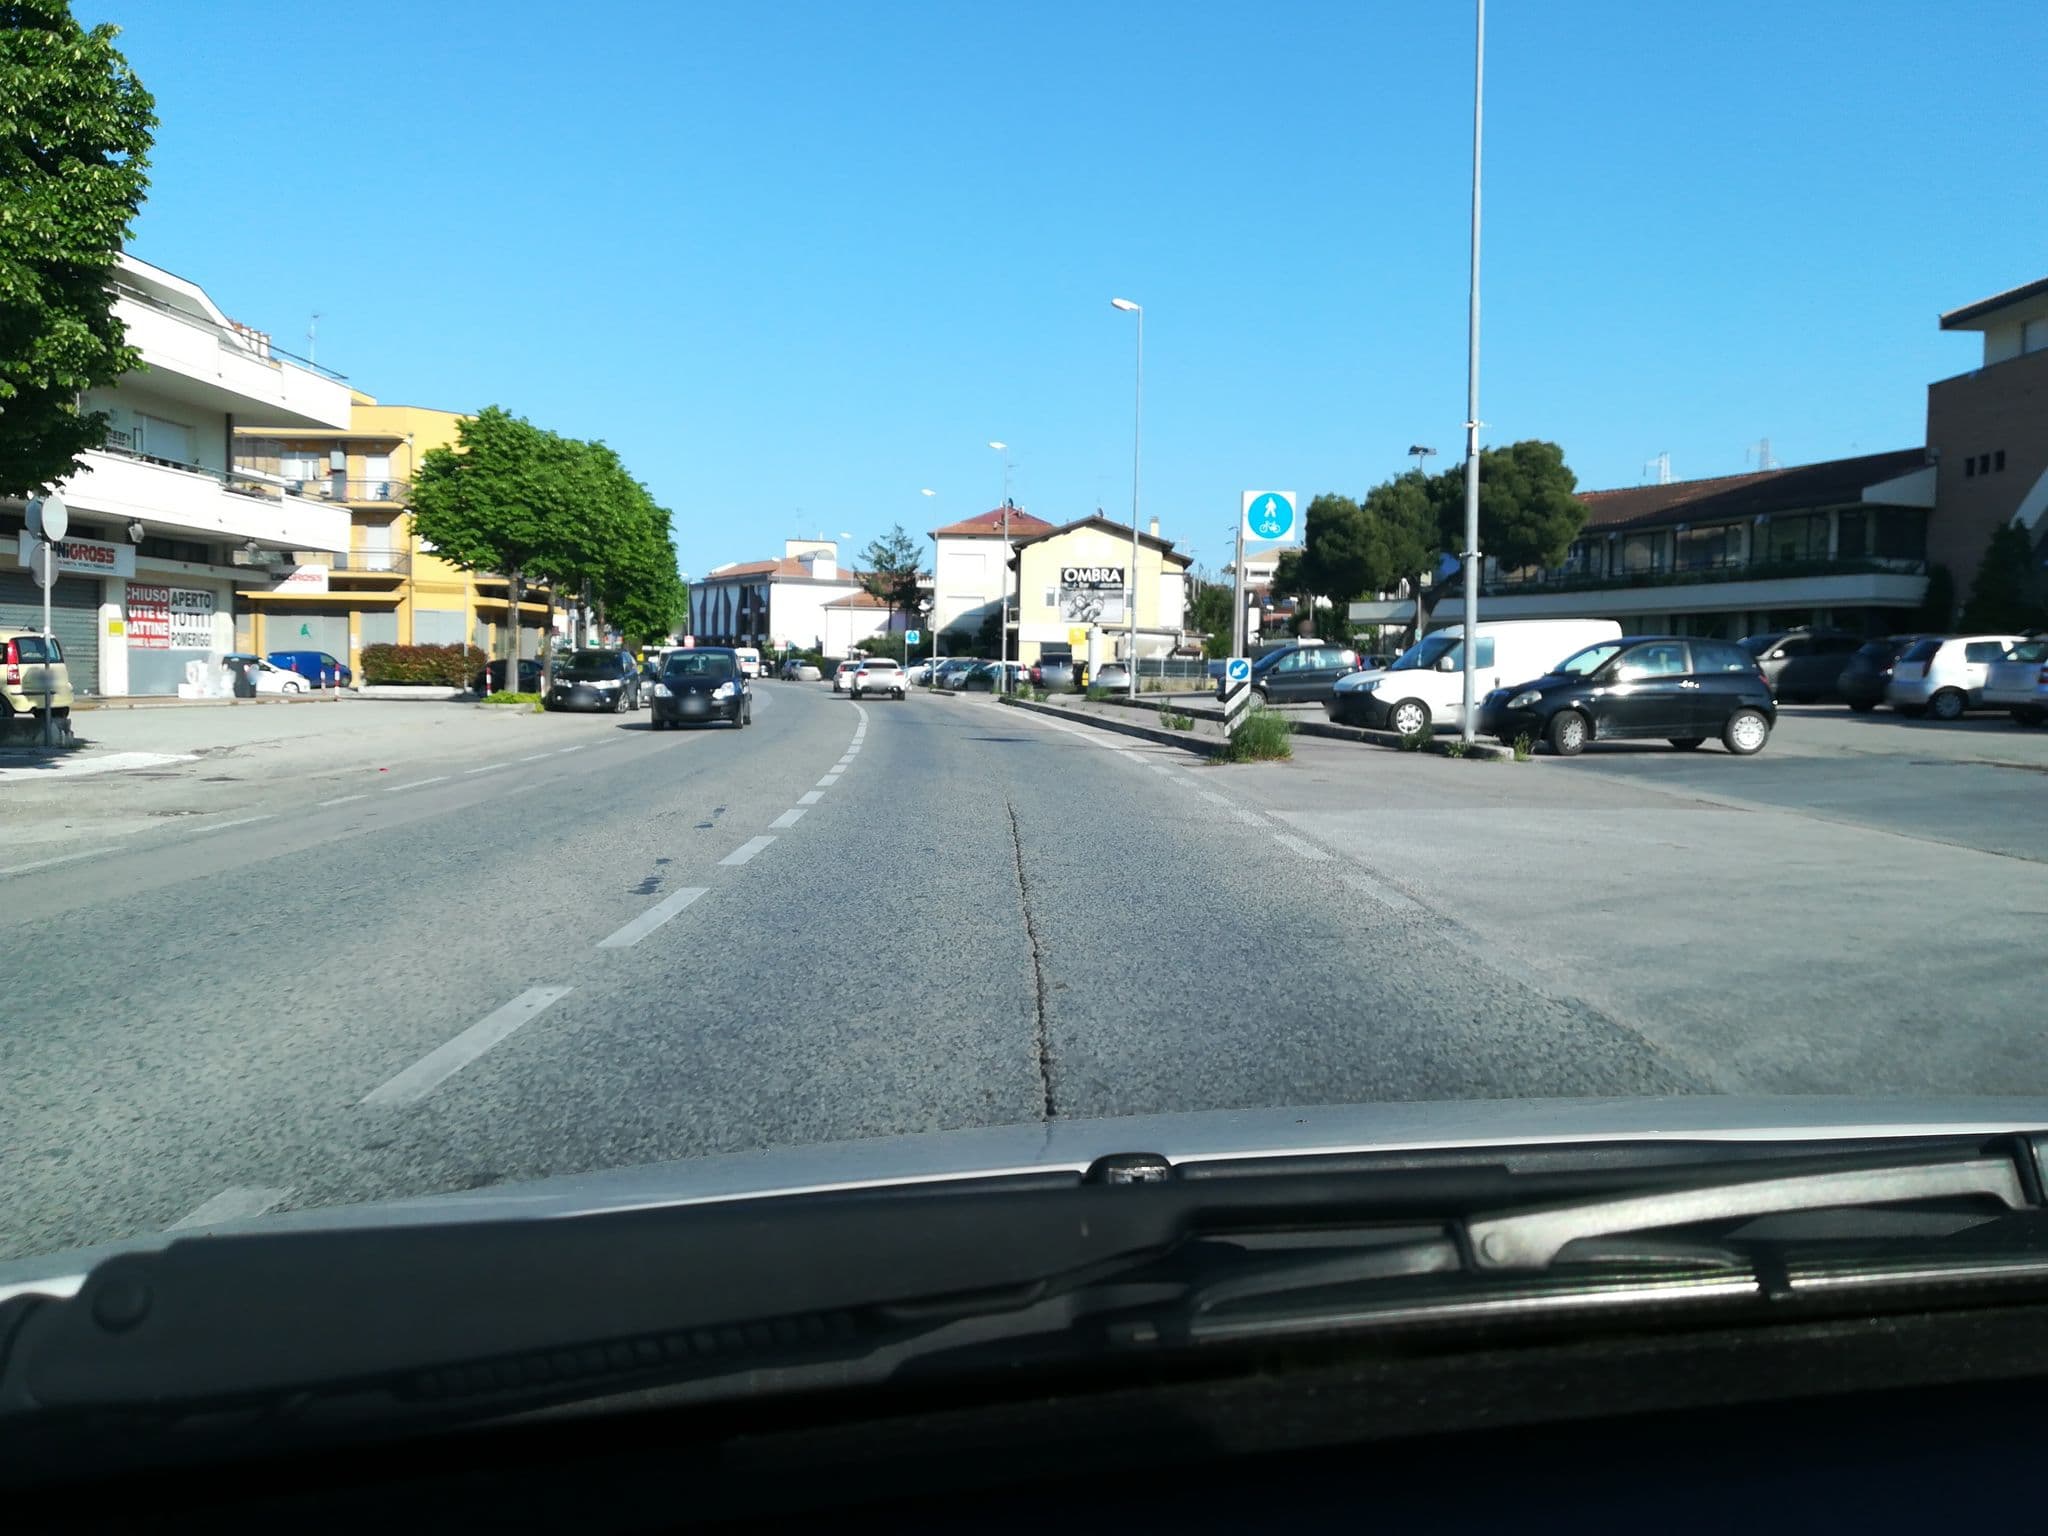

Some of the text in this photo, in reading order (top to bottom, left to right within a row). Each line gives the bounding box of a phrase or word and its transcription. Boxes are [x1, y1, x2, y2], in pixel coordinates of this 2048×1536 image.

[1064, 568, 1121, 582] OMBRA
[171, 592, 212, 609] APERTO
[156, 606, 168, 620] LE
[171, 611, 205, 628] TUTTI
